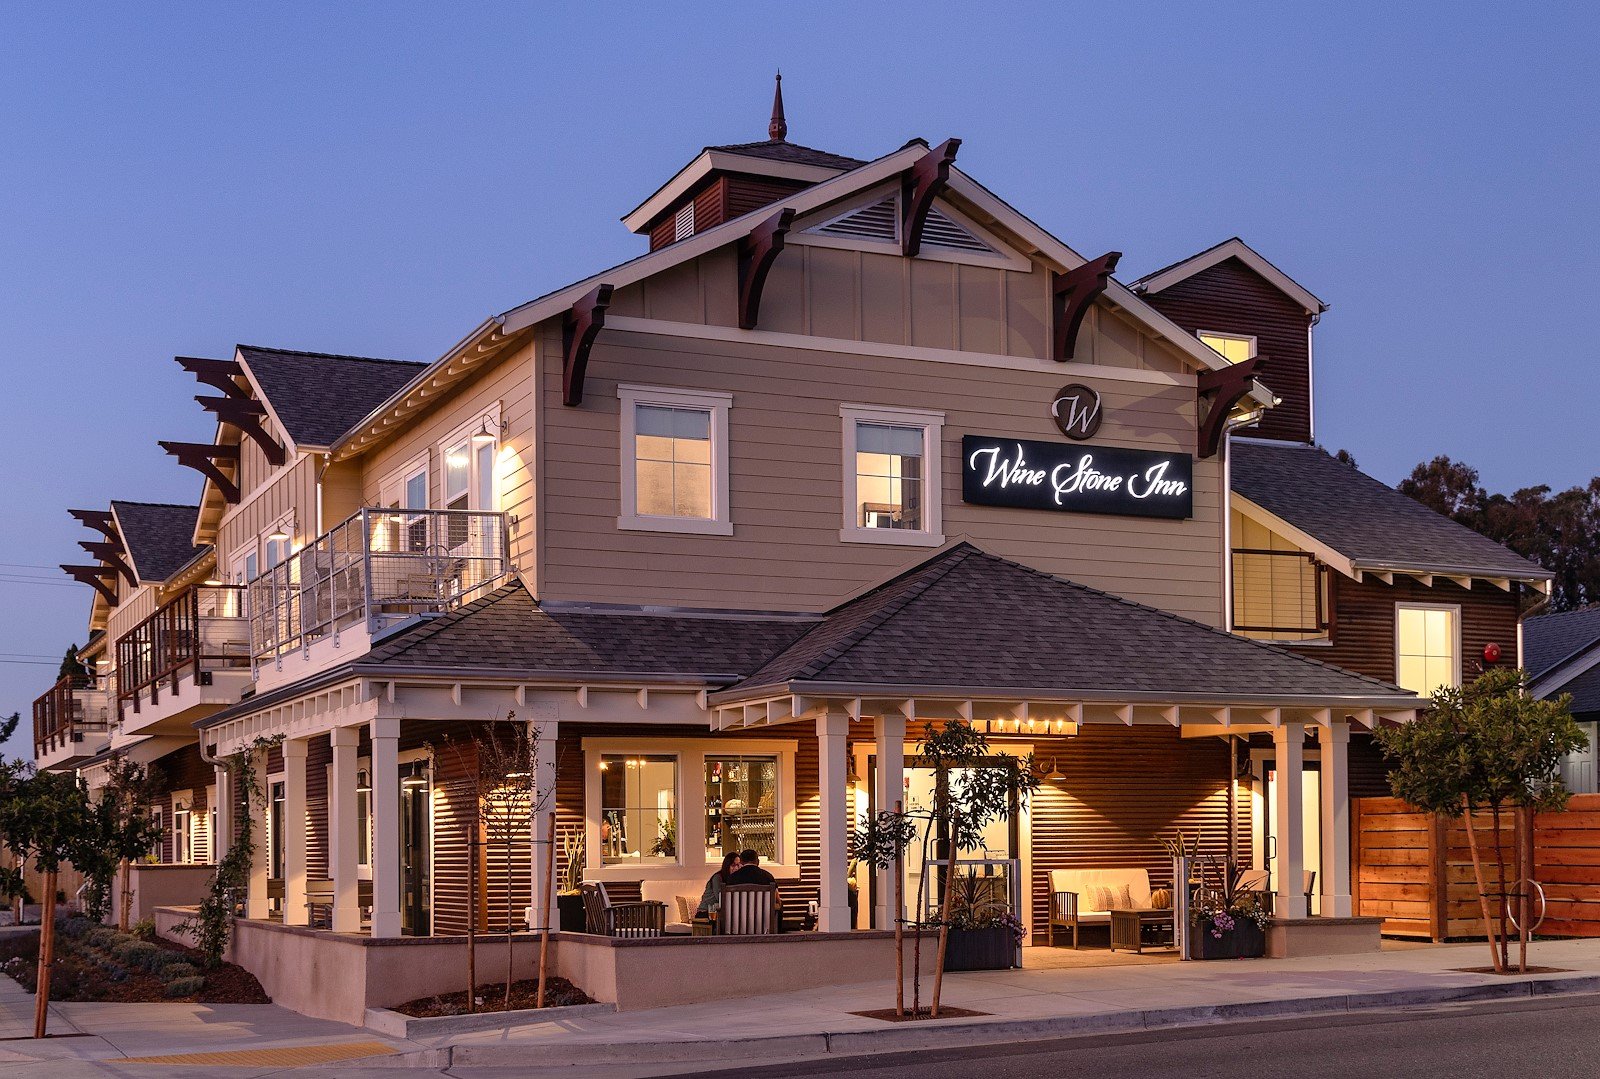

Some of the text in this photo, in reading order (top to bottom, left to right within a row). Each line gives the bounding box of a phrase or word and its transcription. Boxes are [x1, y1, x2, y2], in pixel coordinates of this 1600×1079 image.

[1051, 390, 1100, 433] W
[969, 443, 1188, 505] Wine Stone Inn
